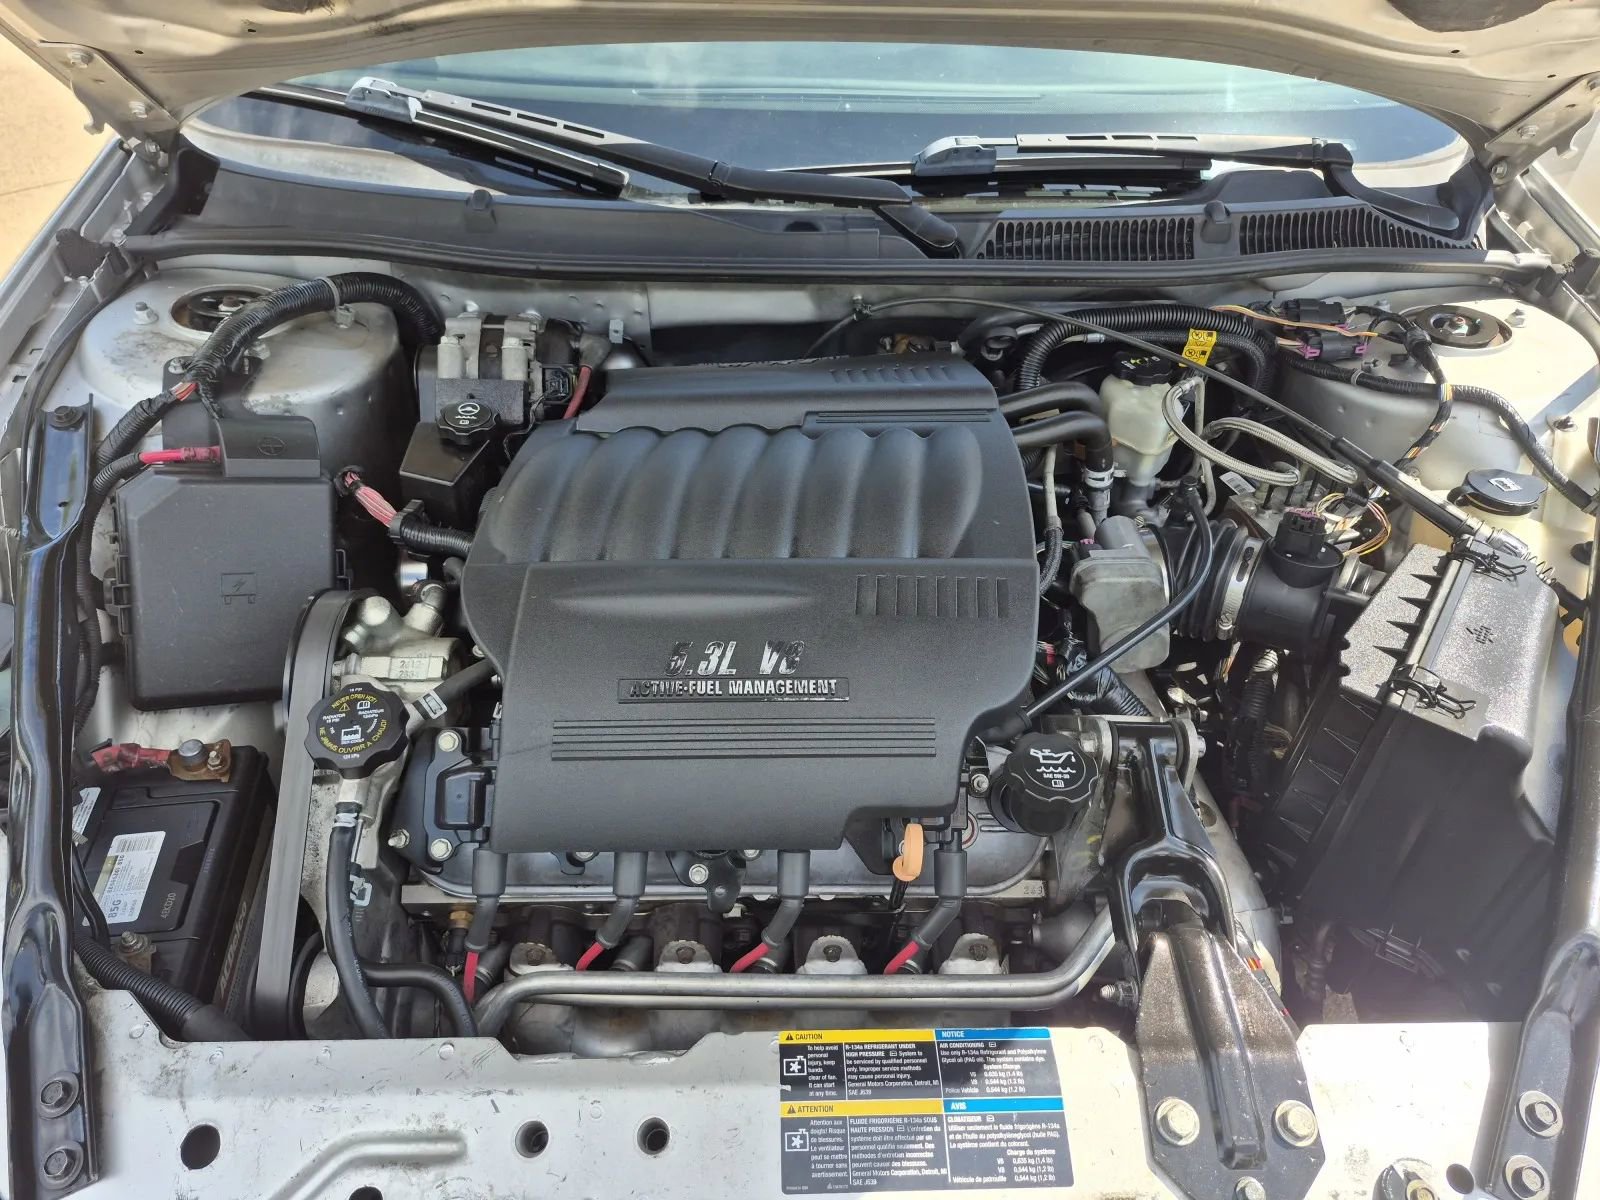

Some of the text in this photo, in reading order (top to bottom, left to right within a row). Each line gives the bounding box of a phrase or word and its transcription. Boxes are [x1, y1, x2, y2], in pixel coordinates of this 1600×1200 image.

[664, 641, 804, 676] 5.3L V8
[729, 679, 836, 695] MANAGEMENT
[331, 696, 349, 708] NEVER
[320, 727, 326, 735] NE
[321, 737, 338, 751] JAMAIS
[338, 744, 365, 753] OUVRIR
